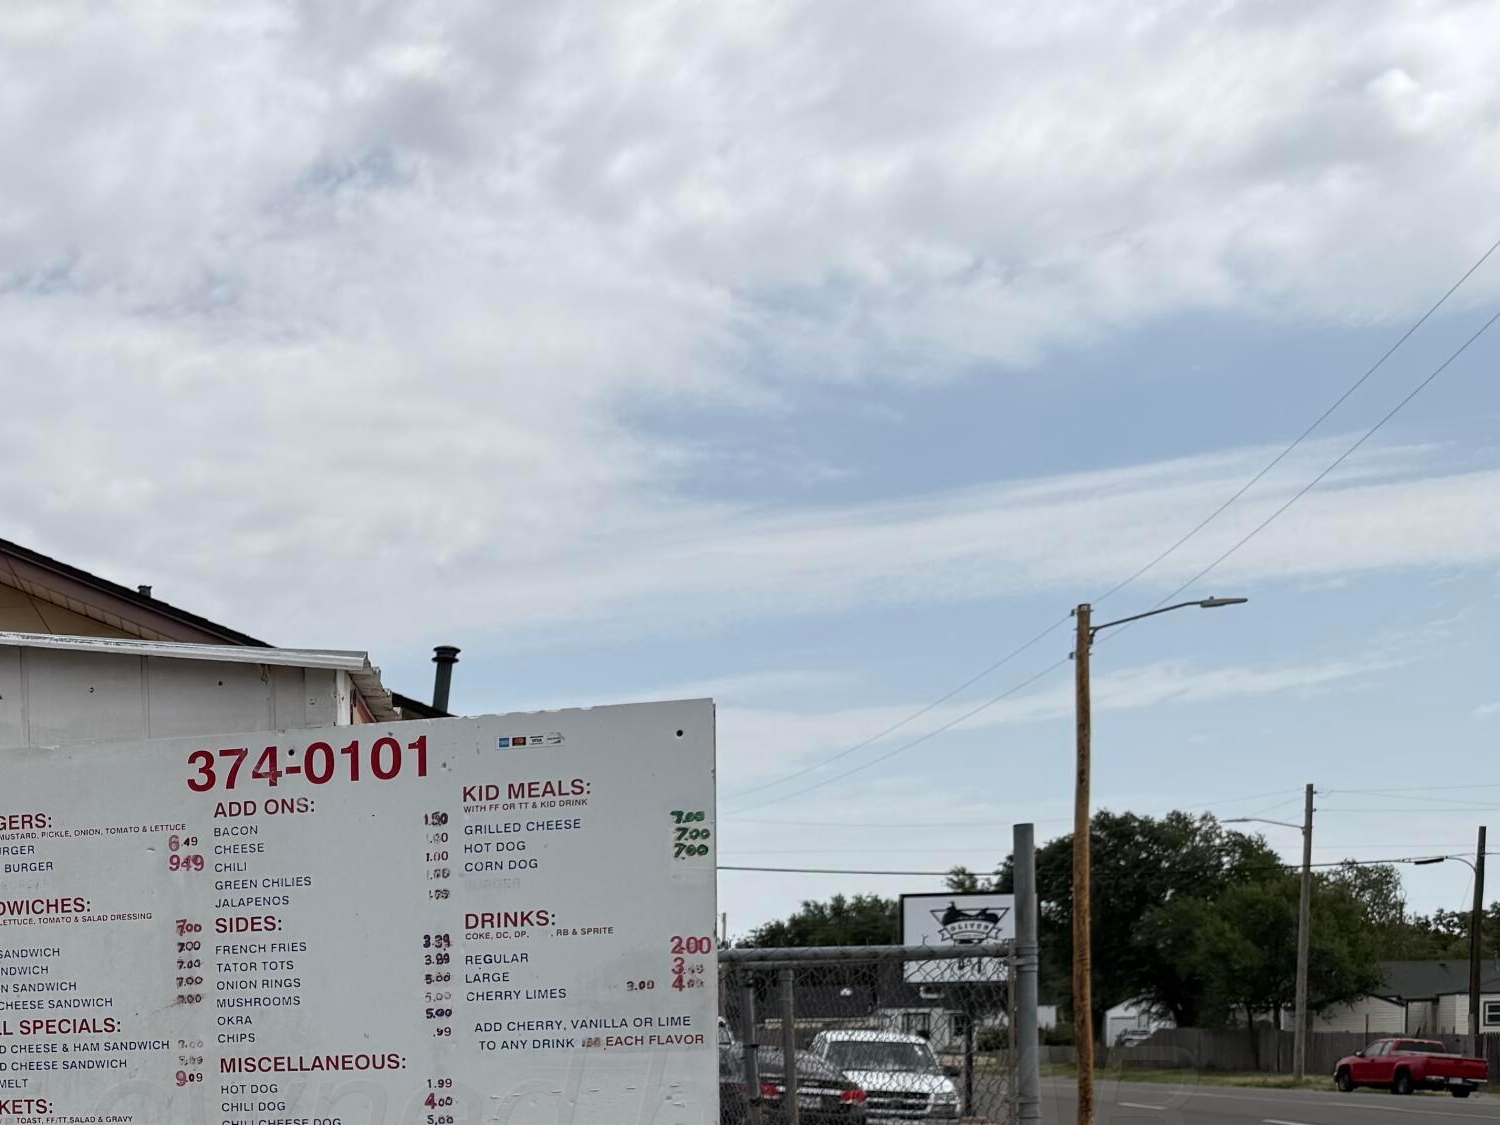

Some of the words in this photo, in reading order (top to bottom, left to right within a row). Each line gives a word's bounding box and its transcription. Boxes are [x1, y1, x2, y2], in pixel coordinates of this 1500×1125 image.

[187, 735, 428, 793] 374-0101
[463, 784, 499, 802] KID
[508, 778, 590, 800] MEALS:
[214, 800, 256, 818] ADD
[264, 797, 314, 815] ONS:
[463, 805, 486, 813] WITH
[540, 800, 555, 808] KID
[558, 798, 587, 806] DRINK
[105, 826, 139, 834] TOMATO
[150, 823, 186, 832] LETTUCE
[214, 825, 257, 836] BACON
[464, 822, 521, 835] GRILLED
[526, 818, 580, 831] CHEESE
[214, 843, 264, 854] CHEESE
[464, 842, 491, 853] HOT
[496, 840, 525, 851] DOG
[4, 861, 53, 873] BURGER
[214, 862, 246, 872] CHILI
[464, 860, 502, 872] CORN
[508, 858, 537, 869] DOG
[214, 879, 257, 890] GREEN
[262, 876, 311, 888] CHILIES
[215, 895, 289, 908] JALAPENOS
[38, 916, 71, 924] TOMATO
[81, 914, 108, 922] SALAD
[110, 912, 152, 920] DRESSING
[215, 915, 281, 933] SIDES:
[465, 910, 555, 929] DRINKS:
[556, 927, 570, 936] RB
[580, 926, 614, 935] SPRITE
[216, 944, 266, 954] FRENCH
[271, 942, 306, 952] FRIES
[465, 953, 528, 965] REGULAR
[216, 961, 256, 972] TATOR
[261, 960, 293, 970] TOTS
[465, 972, 509, 983] LARGE
[12, 981, 76, 992] SANDWICH
[216, 980, 256, 990] ONION
[262, 978, 300, 988] RINGS
[466, 990, 520, 1001] CHERRY
[526, 988, 566, 999] LIMES
[48, 998, 112, 1008] SANDWICH
[216, 996, 300, 1008] MUSHROOMS
[20, 1017, 120, 1035] SPECIALS:
[217, 1015, 252, 1025] OKRA
[474, 1022, 502, 1032] ADD
[570, 1018, 628, 1029] VANILLA
[633, 1017, 652, 1027] OR
[658, 1016, 690, 1026] LIME
[218, 1033, 255, 1043] CHIPS
[479, 1040, 496, 1050] TO
[501, 1040, 527, 1049] ANY
[532, 1038, 574, 1048] DRINK
[605, 1035, 644, 1046] EACH
[649, 1034, 704, 1044] FLAVOR
[10, 1043, 57, 1053] CHEESE
[74, 1042, 99, 1051] HAM
[104, 1040, 169, 1051] SANDWICH
[11, 1061, 58, 1070] CHEESE
[62, 1059, 126, 1069] SANDWICH
[220, 1053, 405, 1073] MISCELLANEOUS:
[221, 1084, 246, 1094] HOT
[250, 1084, 277, 1093] DOG
[427, 1078, 452, 1088] 1.99
[222, 1102, 253, 1112] CHILI
[258, 1101, 285, 1111] DOG
